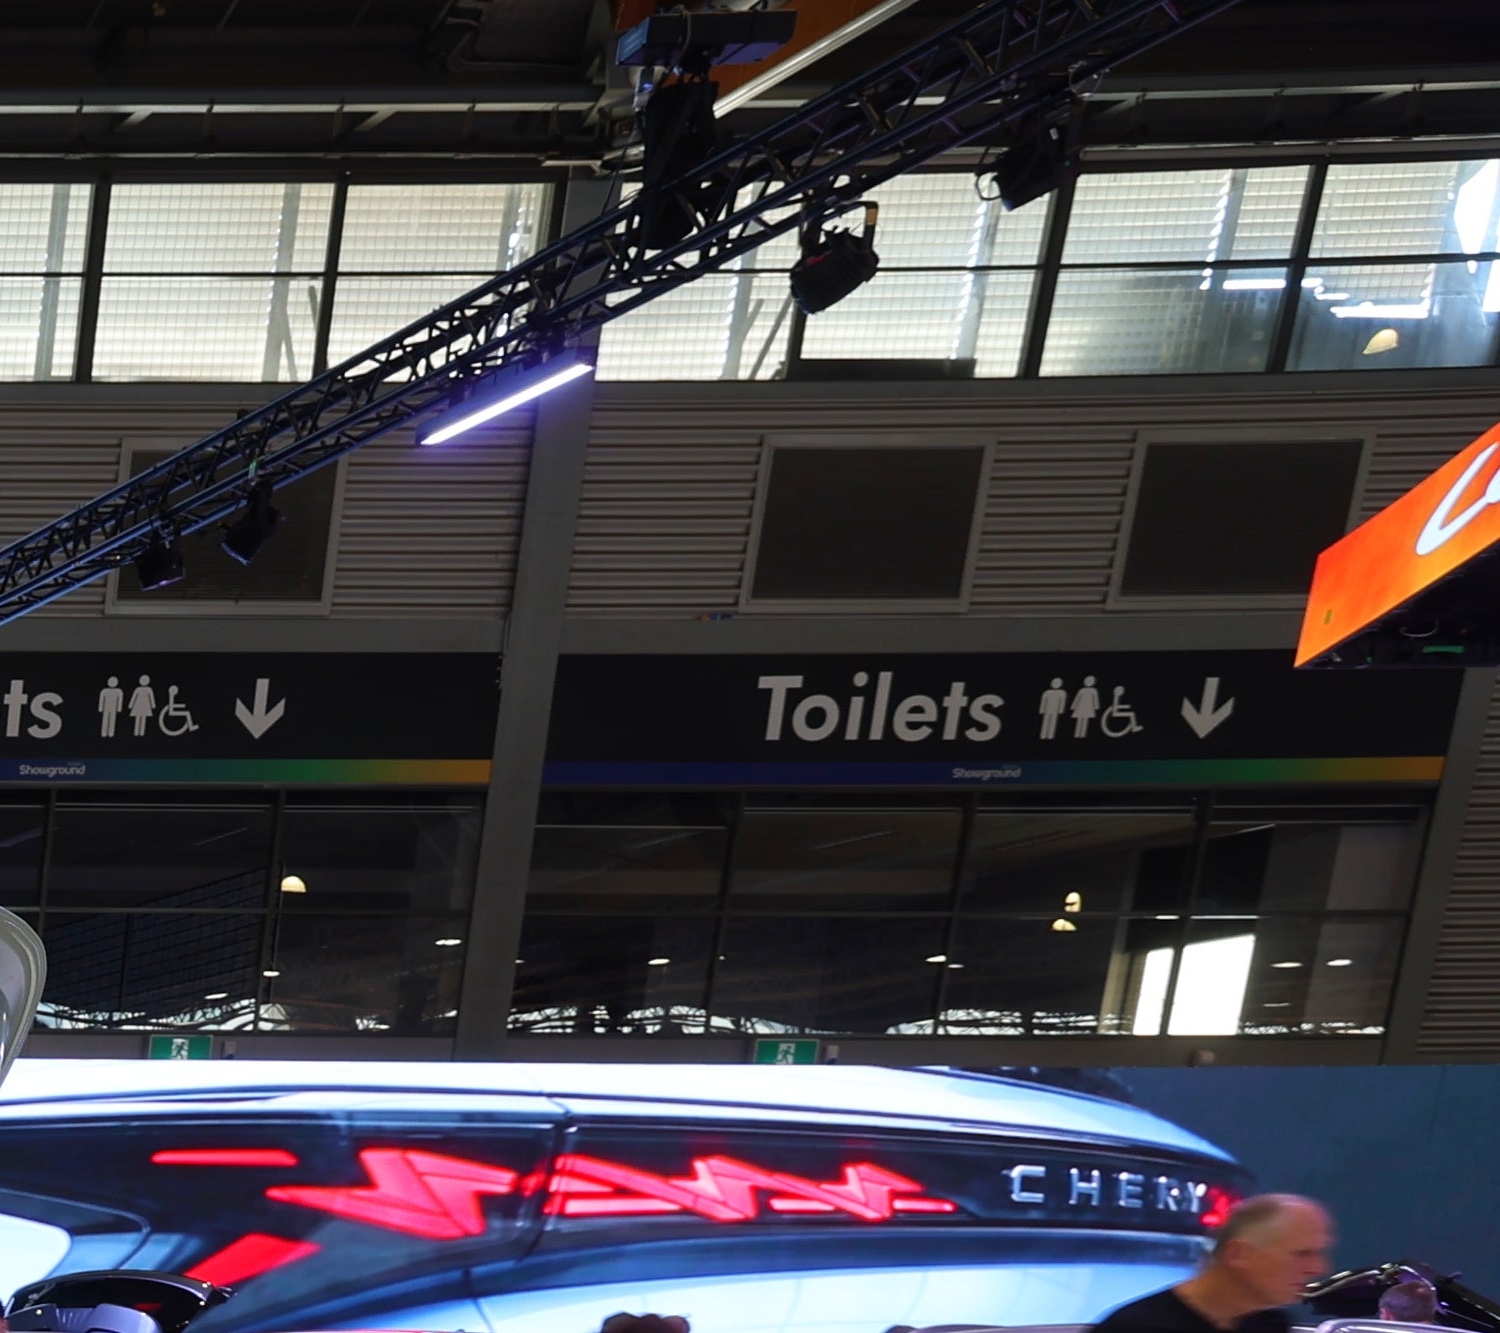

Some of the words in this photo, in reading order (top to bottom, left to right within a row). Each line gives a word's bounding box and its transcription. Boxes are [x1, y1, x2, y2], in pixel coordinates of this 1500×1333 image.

[756, 670, 1005, 742] Toilets
[19, 763, 86, 778] Showground
[952, 767, 1022, 781] Showground
[1010, 1164, 1207, 1213] CHERY
